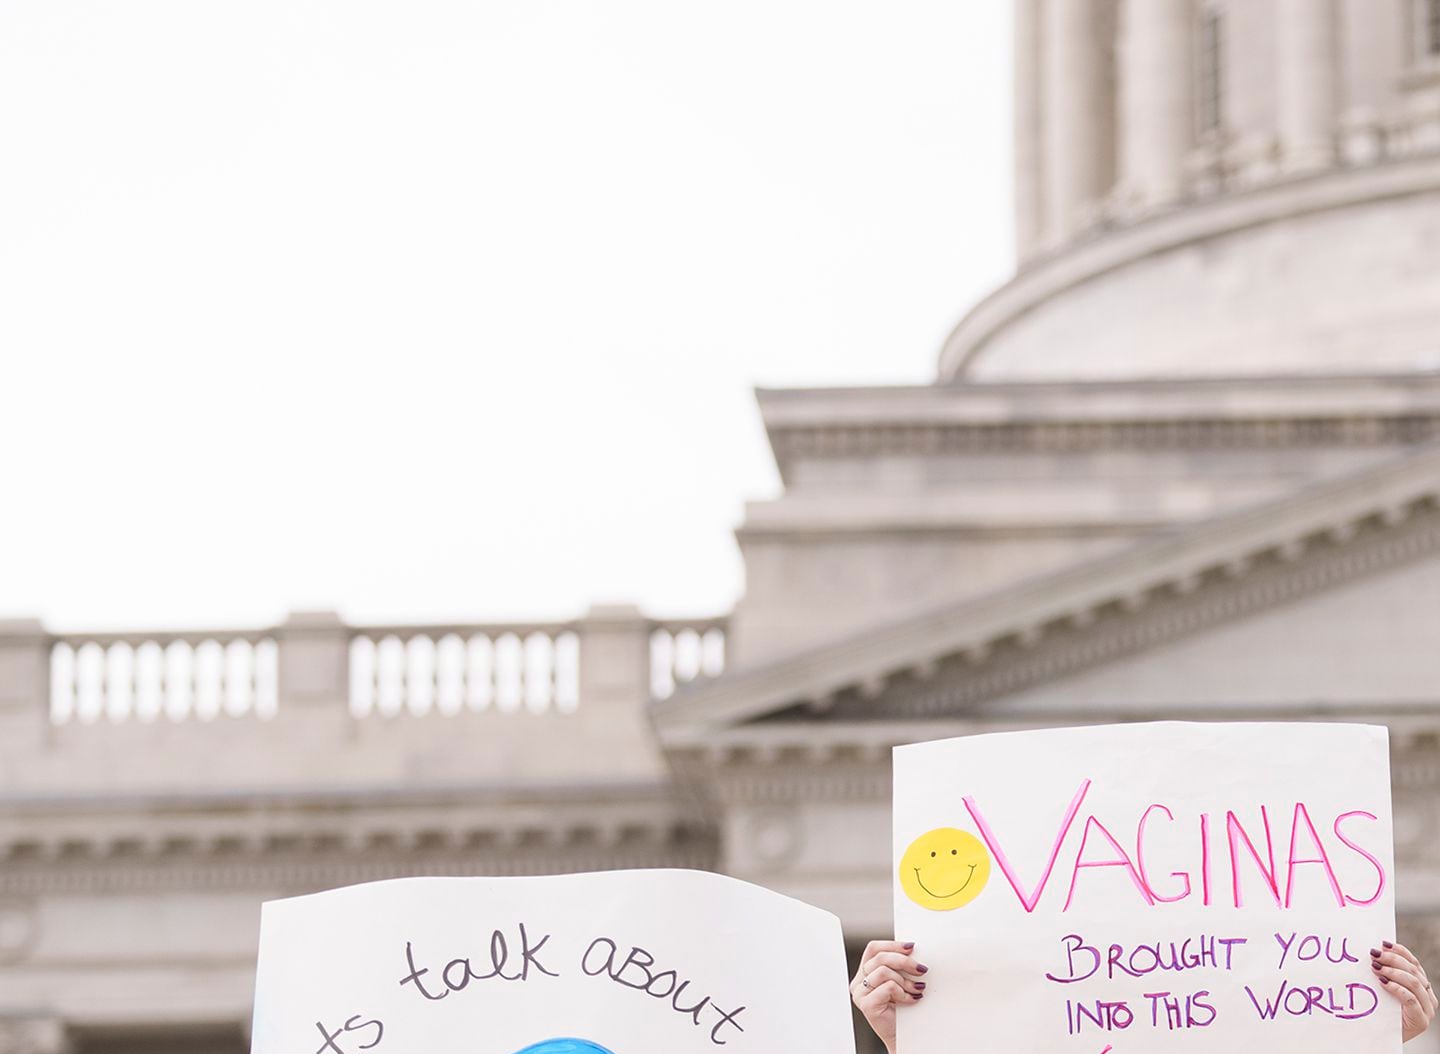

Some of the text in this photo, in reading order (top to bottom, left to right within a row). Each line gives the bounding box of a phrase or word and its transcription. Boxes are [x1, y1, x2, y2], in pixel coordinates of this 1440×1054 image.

[962, 778, 1385, 913] VAGINAS
[400, 923, 559, 1000] talk
[1046, 932, 1360, 983] BROUGHT YOU
[1067, 980, 1379, 1035] INTO THIS WORLD
